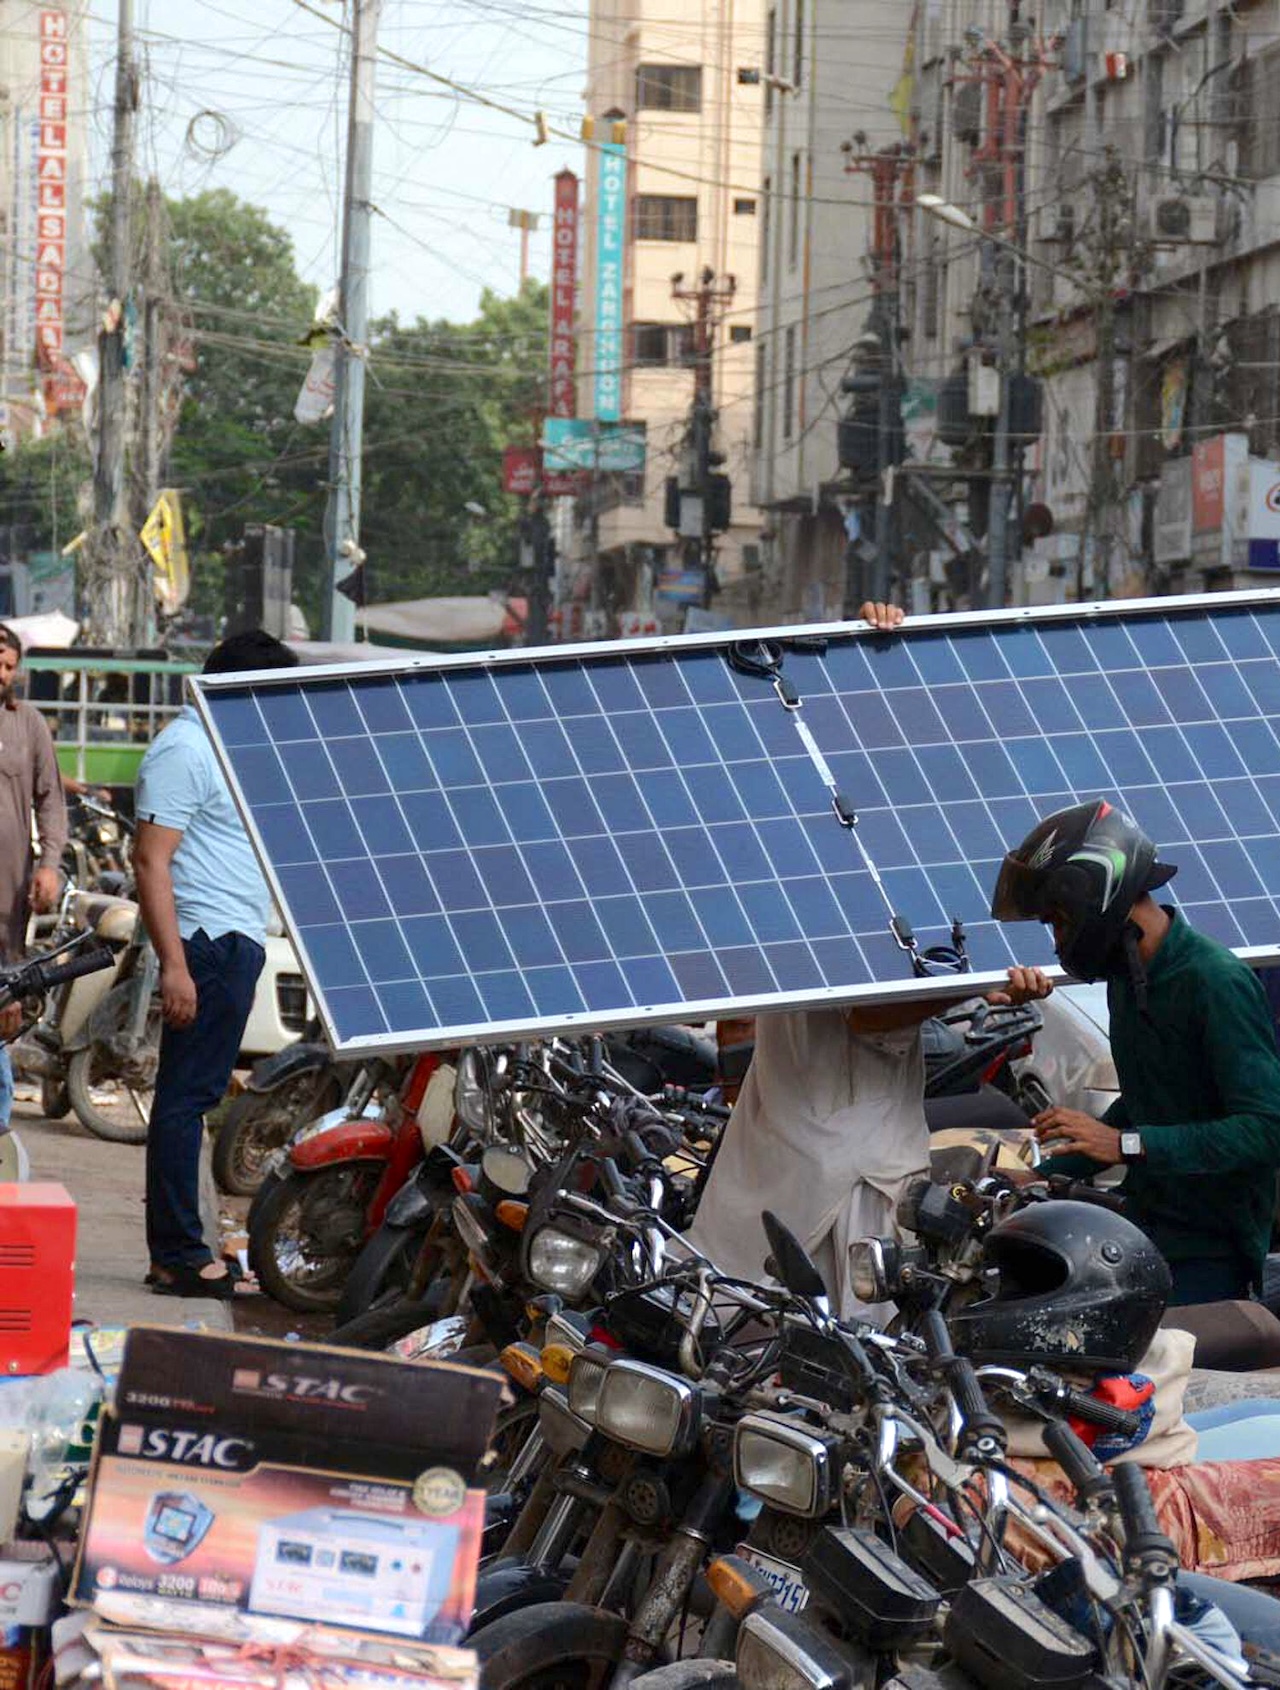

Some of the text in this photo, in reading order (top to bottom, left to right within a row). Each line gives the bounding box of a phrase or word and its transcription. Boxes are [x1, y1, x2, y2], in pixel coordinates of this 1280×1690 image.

[43, 15, 65, 148] HOTEL
[41, 157, 63, 208] AL
[602, 154, 622, 249] HOTEL
[556, 207, 574, 307] HOTEL
[261, 1372, 375, 1403] STAC
[143, 1428, 247, 1467] STAC
